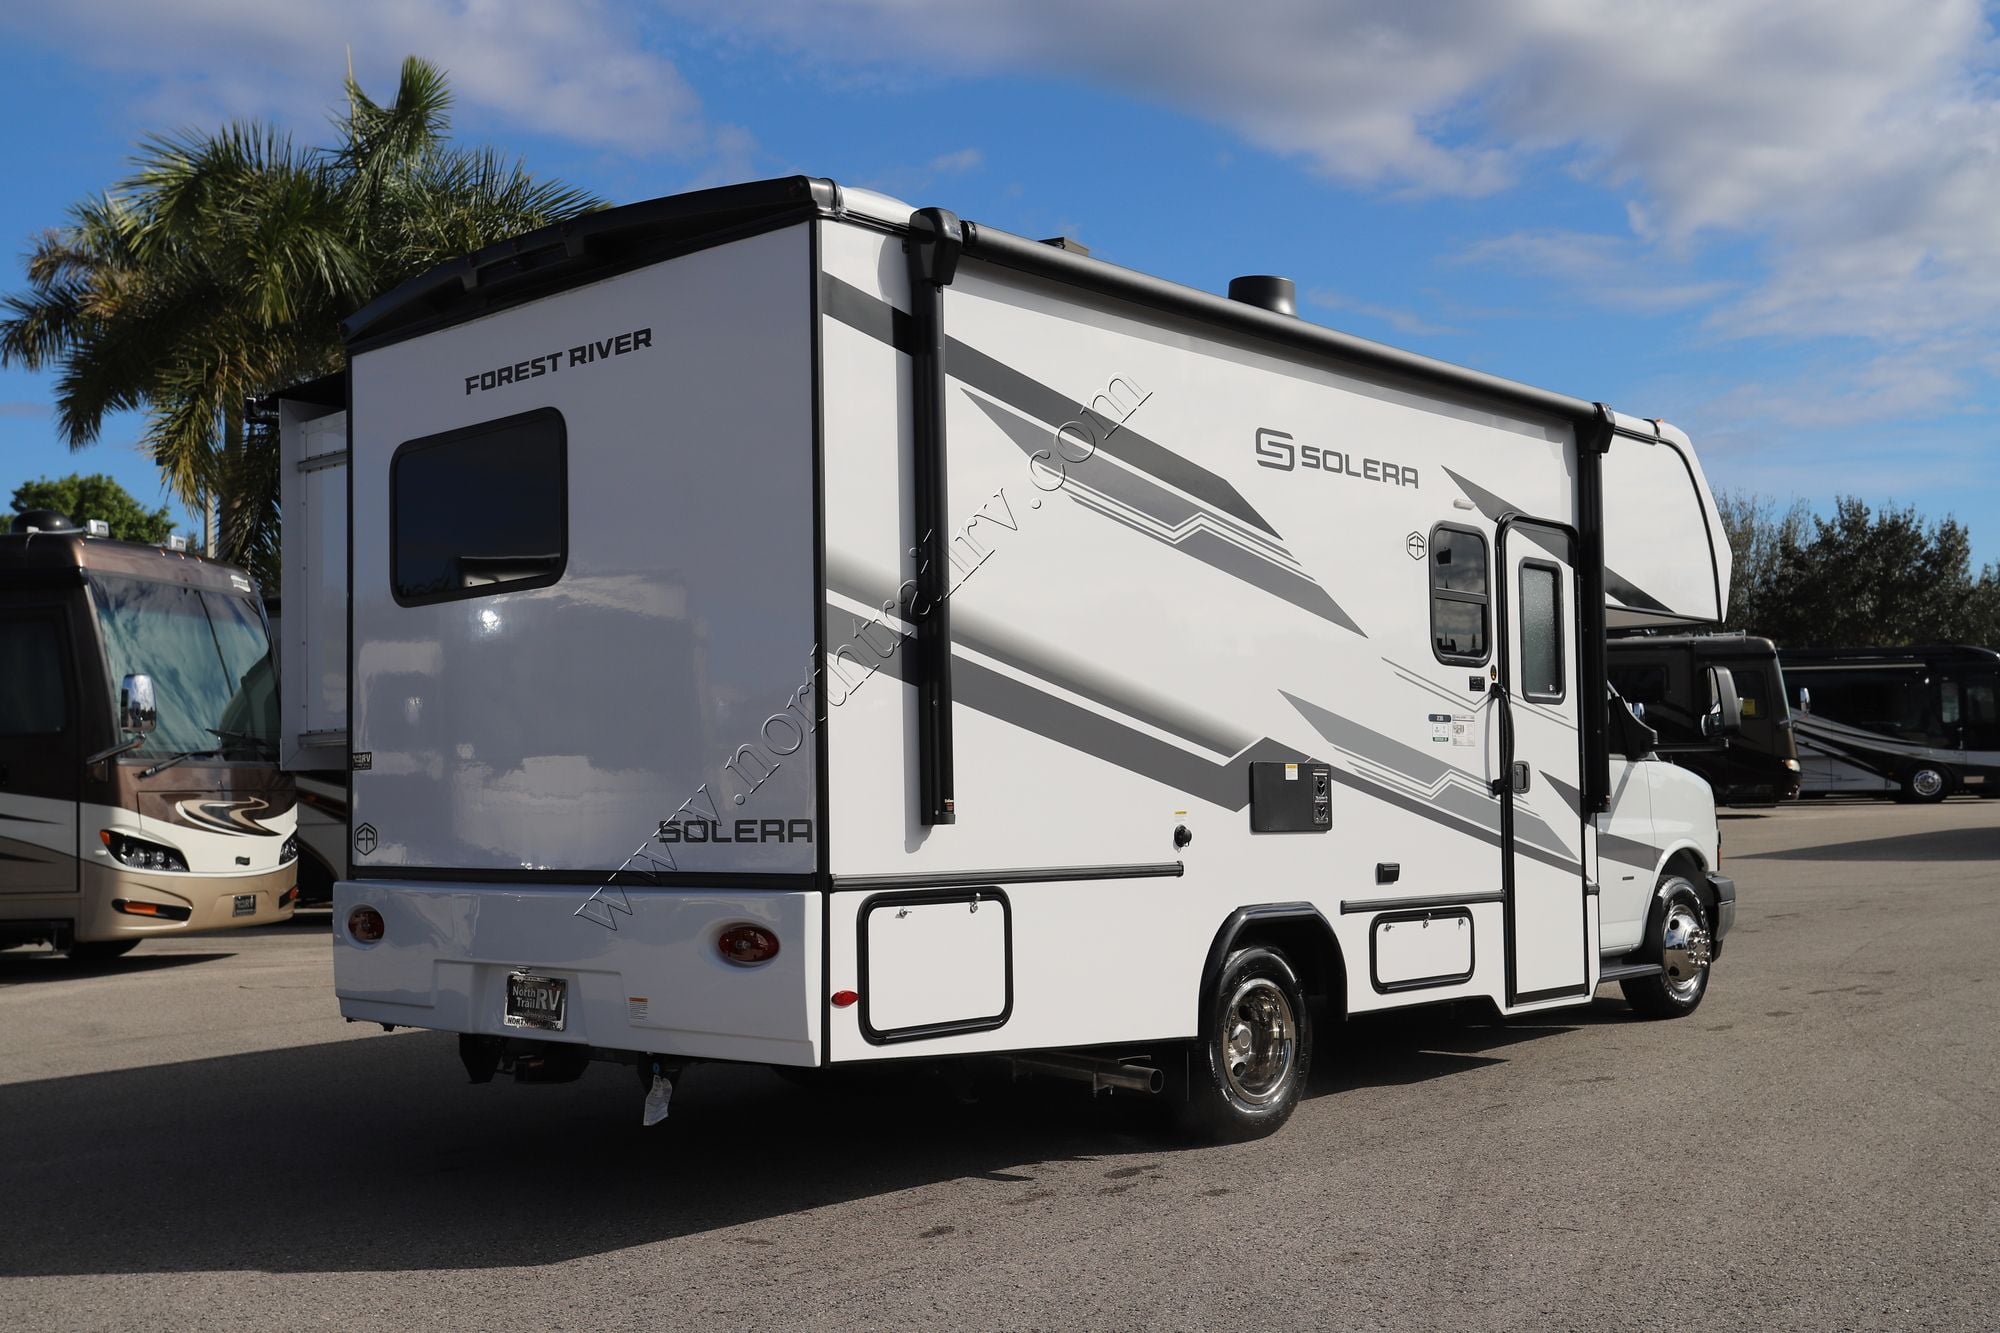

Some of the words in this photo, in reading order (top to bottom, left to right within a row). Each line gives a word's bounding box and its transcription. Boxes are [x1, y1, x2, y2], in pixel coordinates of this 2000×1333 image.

[464, 352, 563, 396] FOREST
[567, 327, 653, 368] RIVER
[1301, 444, 1419, 489] SOLERA
[658, 819, 813, 843] SOLERA
[512, 985, 536, 998] North
[516, 996, 536, 1010] Trail
[535, 988, 561, 1011] RV
